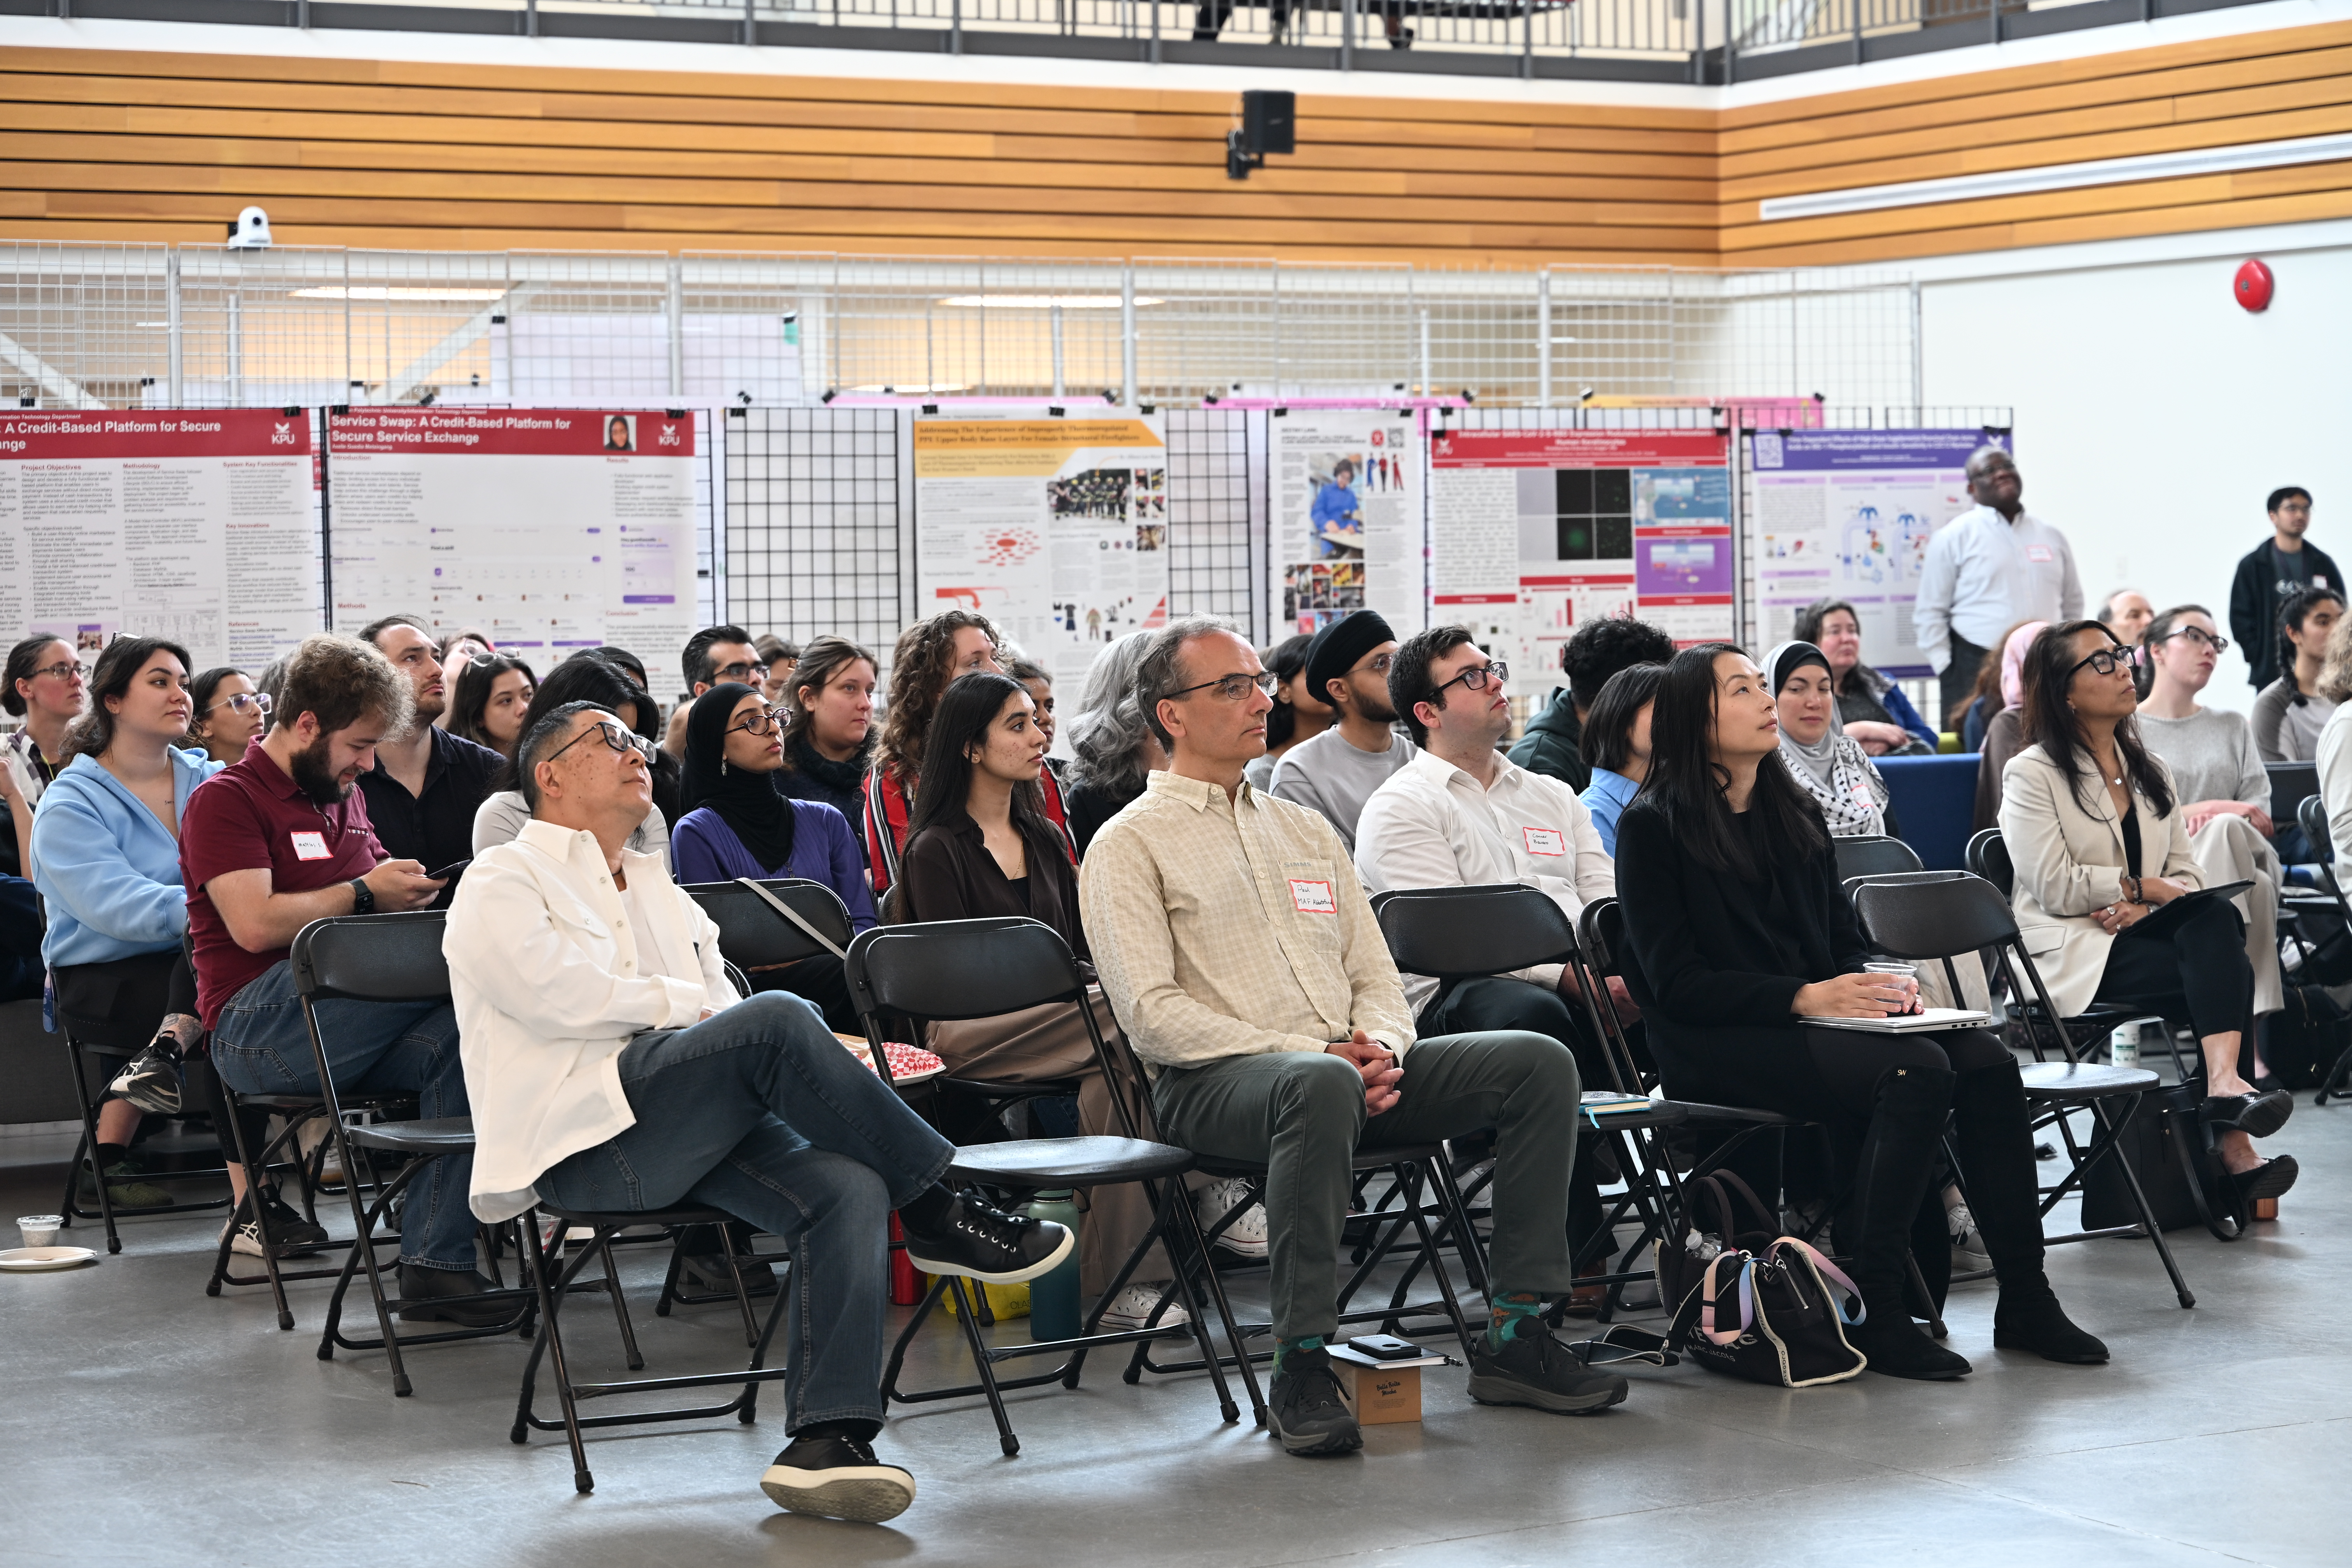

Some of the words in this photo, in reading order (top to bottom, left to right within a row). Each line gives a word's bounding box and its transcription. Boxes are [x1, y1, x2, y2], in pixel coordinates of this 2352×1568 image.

[5, 422, 15, 434] A
[18, 421, 101, 434] Credit-Based
[105, 421, 157, 433] Platform
[160, 420, 177, 432] for
[180, 420, 221, 432] Secure
[331, 415, 376, 427] Service
[379, 415, 416, 429] Swap:
[420, 416, 429, 427] A
[431, 416, 502, 429] Credit-Based
[506, 418, 552, 429] Platform
[555, 419, 571, 429] for
[271, 433, 295, 444] KPU
[332, 430, 374, 442] Secure
[377, 430, 422, 443] Service
[425, 431, 480, 445] Exchange
[659, 436, 680, 446] KPU
[1381, 1388, 1396, 1396] Moche
